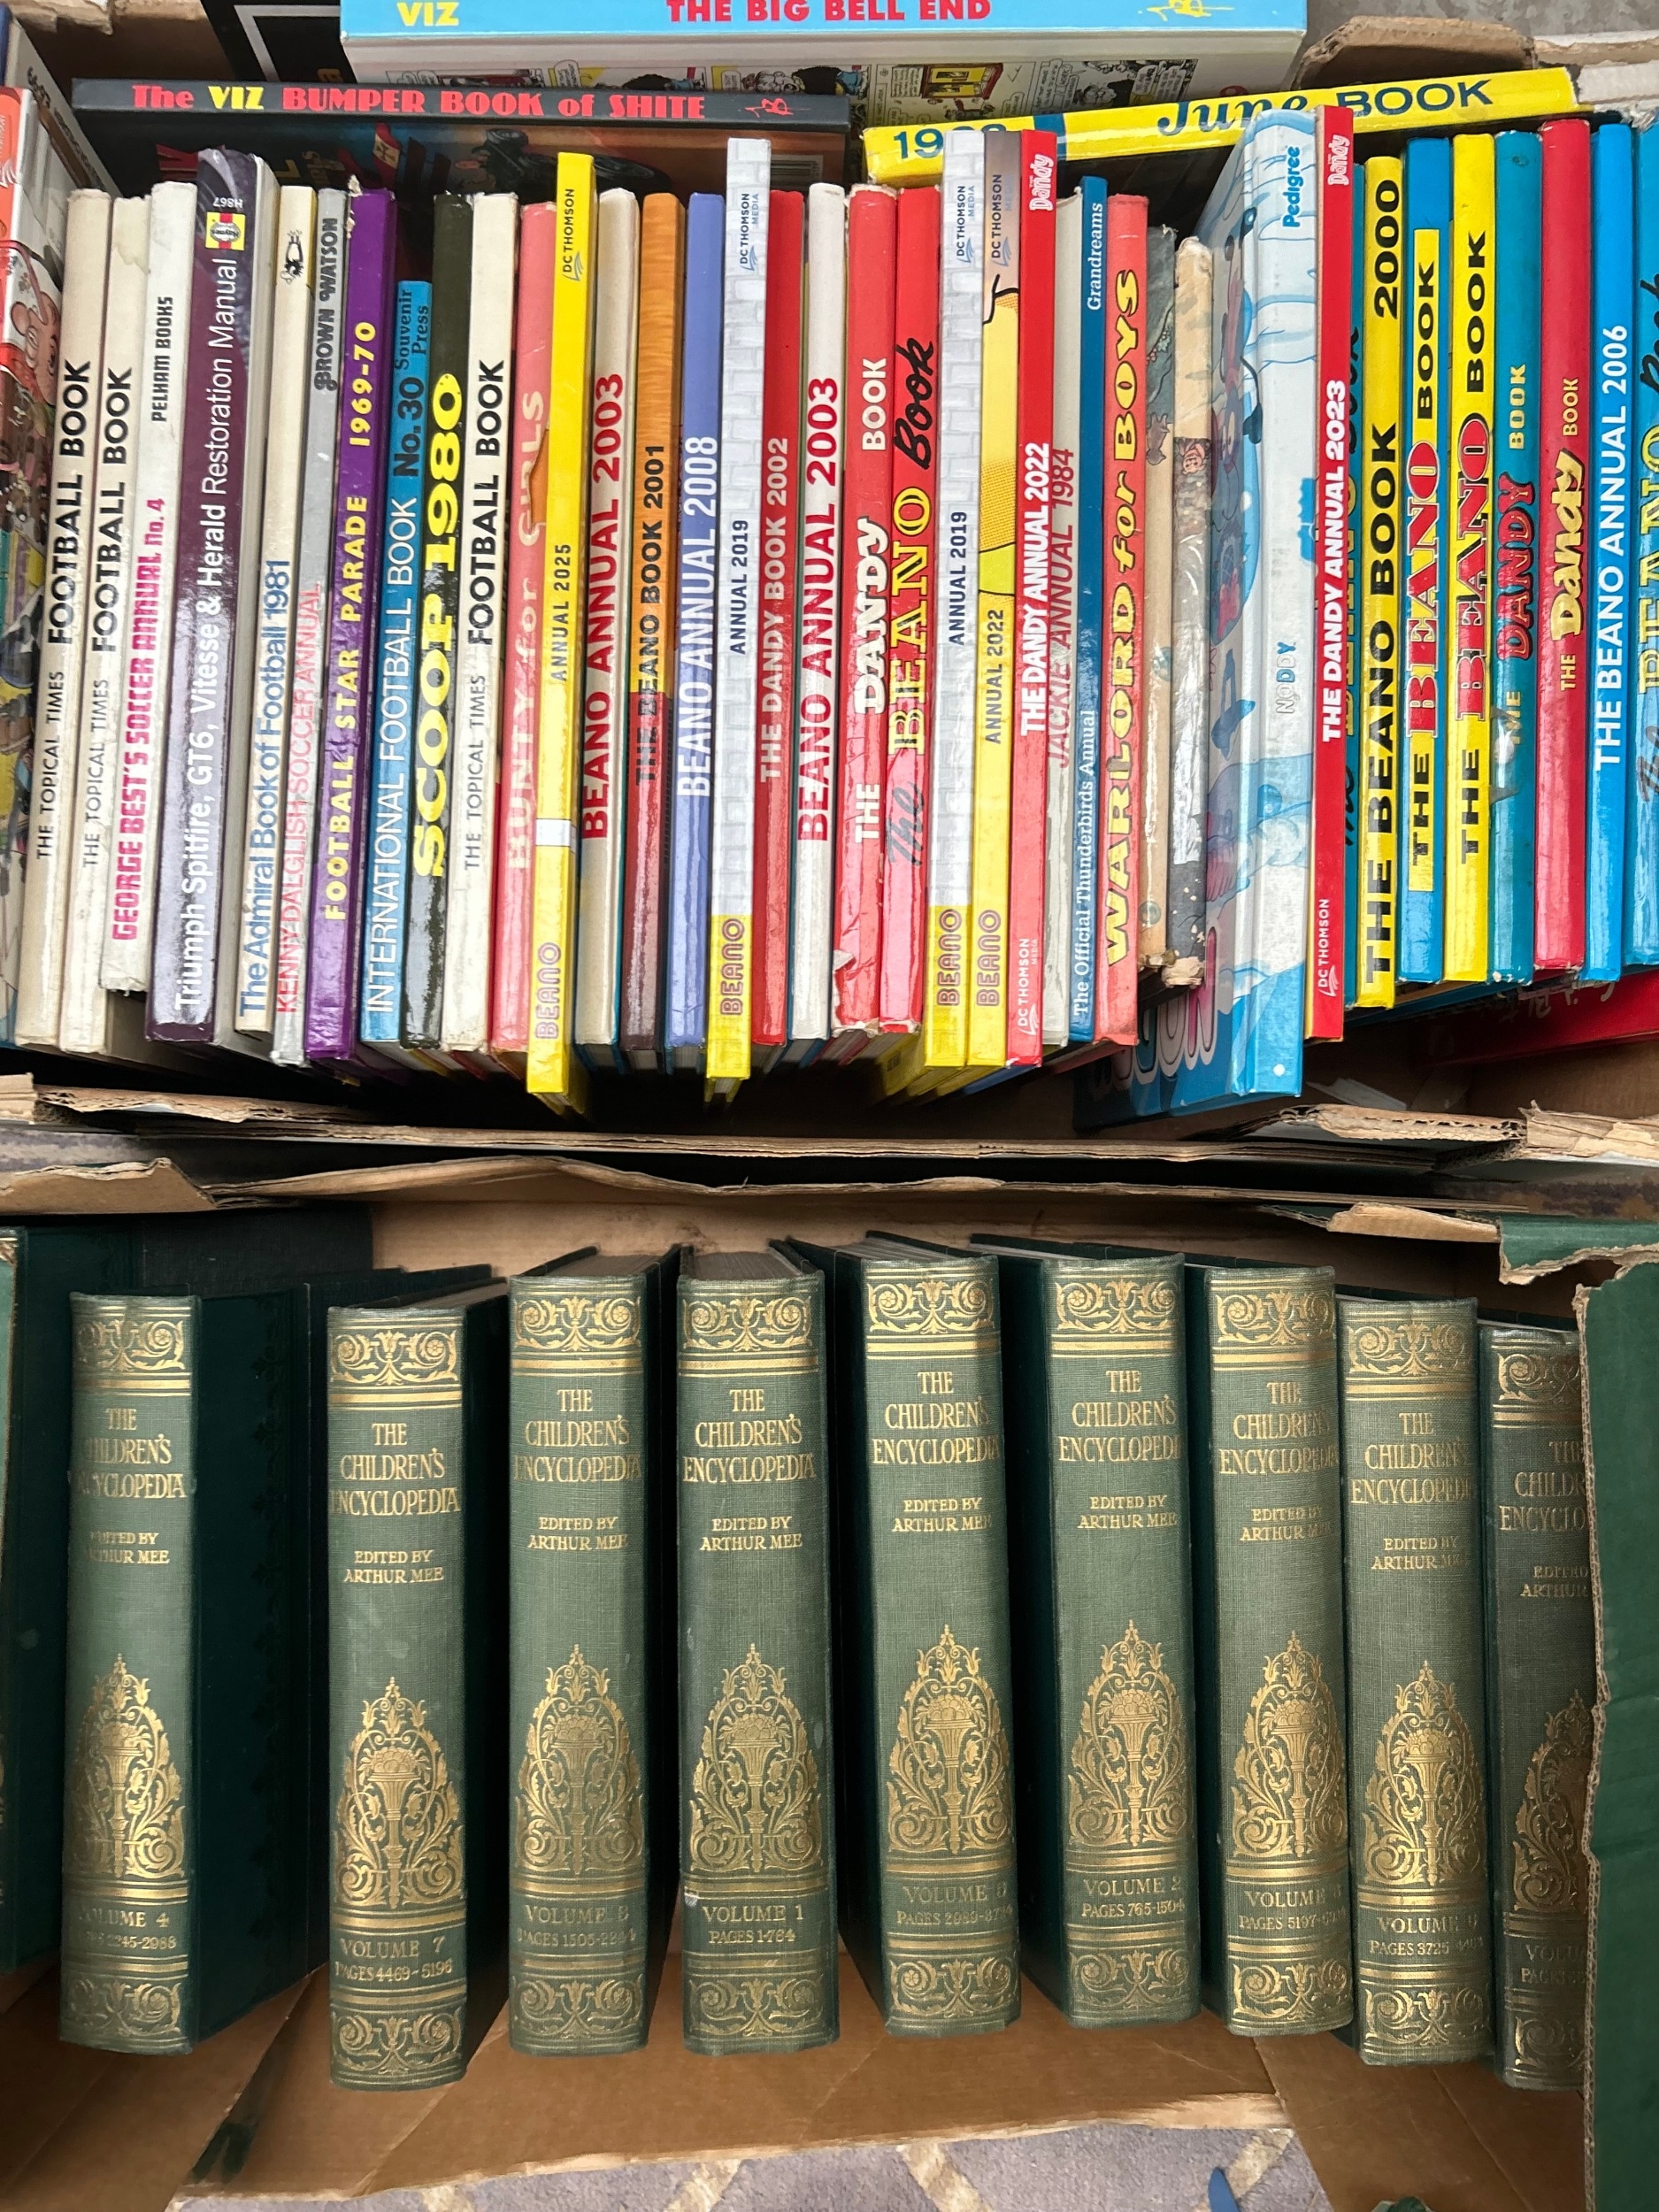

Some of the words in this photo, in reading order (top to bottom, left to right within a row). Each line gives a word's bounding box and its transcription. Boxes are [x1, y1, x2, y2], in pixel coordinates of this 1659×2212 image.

[397, 1, 458, 27] VIZ
[667, 0, 731, 22] THE
[747, 0, 809, 21] BIG
[825, 0, 904, 20] BELL
[919, 0, 990, 19] END
[133, 85, 195, 109] The
[208, 86, 264, 110] VIZ
[282, 87, 425, 113] BUMPER
[441, 90, 543, 116] BOOK
[557, 95, 595, 117] of
[610, 94, 704, 119] SHITE
[1338, 79, 1493, 117] BOOK
[213, 196, 243, 208] H867
[750, 192, 759, 224] MEDIA
[1028, 153, 1054, 210] Dandy
[1282, 145, 1302, 227] Pedigree
[563, 187, 575, 252] THOMSON
[740, 192, 750, 247] THOMSON
[1374, 179, 1399, 319] 2000
[319, 218, 338, 300] WATSON
[562, 254, 573, 272] DC
[739, 249, 750, 264] DC
[1087, 202, 1104, 309] Grandreams
[153, 296, 173, 348] BOOKS
[208, 258, 237, 347] Manual
[396, 288, 413, 369] Souvenir
[411, 304, 429, 353] Press
[314, 308, 337, 389] BROWN
[1114, 268, 1139, 461] BOYS
[1417, 260, 1434, 419] BOOK
[1601, 324, 1628, 394] 2006
[61, 360, 89, 457] BOOK
[150, 355, 171, 421] PELHAM
[349, 320, 375, 445] 1969-70
[396, 377, 424, 419] 30
[861, 357, 887, 450] BOOK
[893, 336, 934, 468] Book
[1562, 378, 1579, 435] BOOK
[203, 358, 233, 493] Restoration
[393, 426, 419, 475] No.
[1325, 380, 1346, 459] 2023
[147, 498, 165, 511] 4
[426, 372, 463, 572] 1980
[643, 444, 665, 508] 2001
[1599, 405, 1626, 556] ANNUAL
[388, 496, 417, 584] BOOK
[1112, 470, 1137, 572] for
[1325, 465, 1344, 577] ANNUAL
[1369, 422, 1397, 595] BOOK
[48, 474, 82, 643] FOOTBALL
[197, 503, 227, 586] Herald
[340, 495, 367, 620] PARADE
[640, 520, 663, 603] BOOK
[731, 518, 749, 566] 2019
[1550, 447, 1586, 640] Dandy
[132, 552, 161, 649] ANNUAL
[196, 594, 221, 614] &
[265, 559, 289, 614] 1981
[729, 573, 748, 654] ANNUAL
[853, 517, 887, 714] DANDY
[1406, 439, 1440, 738] BEANO
[295, 582, 319, 683] ANNUAL
[887, 486, 930, 754] BEANO
[986, 609, 1004, 656] 2022
[1323, 583, 1343, 682] DANDY
[1598, 565, 1624, 687] BEANO
[45, 671, 64, 723] TIMES
[192, 624, 220, 712] Vitesse
[257, 625, 288, 734] Football
[335, 649, 360, 727] STAR
[380, 596, 412, 760] FOOTBALL
[637, 614, 660, 715] BEANO
[1560, 654, 1577, 689] THE
[126, 657, 153, 743] SOCCER
[985, 663, 1002, 743] ANNUAL
[1323, 687, 1343, 741] THE
[1368, 619, 1394, 833] BEANO
[188, 723, 219, 784] GT6,
[254, 741, 280, 769] of
[289, 687, 314, 792] SOCCER
[413, 594, 453, 875] SCOOP
[635, 725, 657, 784] THE
[1078, 710, 1094, 774] Annual
[1594, 700, 1622, 770] THE
[40, 734, 60, 813] TOPICAL
[119, 751, 148, 833] BEST'S
[1105, 582, 1135, 966] WARLORD
[251, 772, 279, 848] Book
[324, 754, 355, 918] FOOTBALL
[856, 782, 881, 842] THE
[886, 780, 924, 863] The
[1076, 780, 1094, 902] Thunderbirds
[1413, 751, 1430, 865] THE
[36, 825, 54, 858] THE
[180, 795, 213, 893] Spitfire,
[281, 800, 307, 921] DALGLISH
[112, 841, 142, 939] GEORGE
[243, 856, 275, 956] Admiral
[366, 772, 404, 1012] INTERNATIONAL
[1366, 859, 1392, 982] THE
[175, 903, 211, 1009] Triumph
[976, 909, 1001, 1005] BEANO
[1074, 909, 1091, 974] Official
[1318, 898, 1330, 965] THOMSON
[240, 963, 267, 1016] The
[278, 926, 301, 1012] KENNY
[719, 917, 744, 1015] BEANO
[1073, 981, 1091, 1015] The
[1317, 968, 1328, 987] DC
[557, 1389, 592, 1411] THE
[730, 1389, 764, 1412] THE
[918, 1371, 954, 1394] THE
[1071, 1395, 1176, 1427] CHILDREN'S
[1106, 1371, 1141, 1393] THE
[341, 1448, 445, 1479] CHILDREN'S
[372, 1423, 407, 1446] THE
[525, 1415, 630, 1447] CHILDREN'S
[695, 1414, 803, 1447] CHILDREN'S
[683, 1453, 815, 1483] ENCYCLOPEDIA
[331, 1487, 460, 1516] ENCYCLOPEDIA
[539, 1517, 593, 1530] EDITED
[596, 1517, 618, 1529] BY
[712, 1517, 767, 1531] EDITED
[771, 1517, 792, 1529] BY
[893, 1517, 959, 1532] ARTHUR
[903, 1498, 957, 1511] EDITED
[962, 1497, 982, 1510] BY
[1078, 1515, 1142, 1529] ARTHUR
[1146, 1513, 1177, 1526] MEE
[1090, 1496, 1143, 1509] EDITED
[1148, 1495, 1167, 1508] BY
[1240, 1526, 1303, 1541] ARTHUR
[344, 1569, 406, 1583] ARTHUR
[410, 1567, 443, 1581] MEE
[355, 1551, 409, 1564] EDITED
[411, 1549, 434, 1563] BY
[528, 1536, 591, 1550] ARTHUR
[596, 1535, 628, 1549] MEE
[701, 1537, 764, 1551] ARTHUR
[770, 1534, 802, 1548] MEE
[1372, 1555, 1436, 1570] ARTHUR
[703, 1905, 786, 1924] VOLUME
[796, 1905, 803, 1921] 1
[1081, 1902, 1125, 1918] PAGES
[1084, 1878, 1165, 1896] VOLUME
[1171, 1878, 1180, 1893] 2
[340, 1939, 419, 1958] VOLUME
[433, 1937, 445, 1953] 7
[709, 1931, 754, 1944] PAGES
[1240, 1915, 1282, 1930] PAGES
[1370, 1940, 1414, 1955] PAGES
